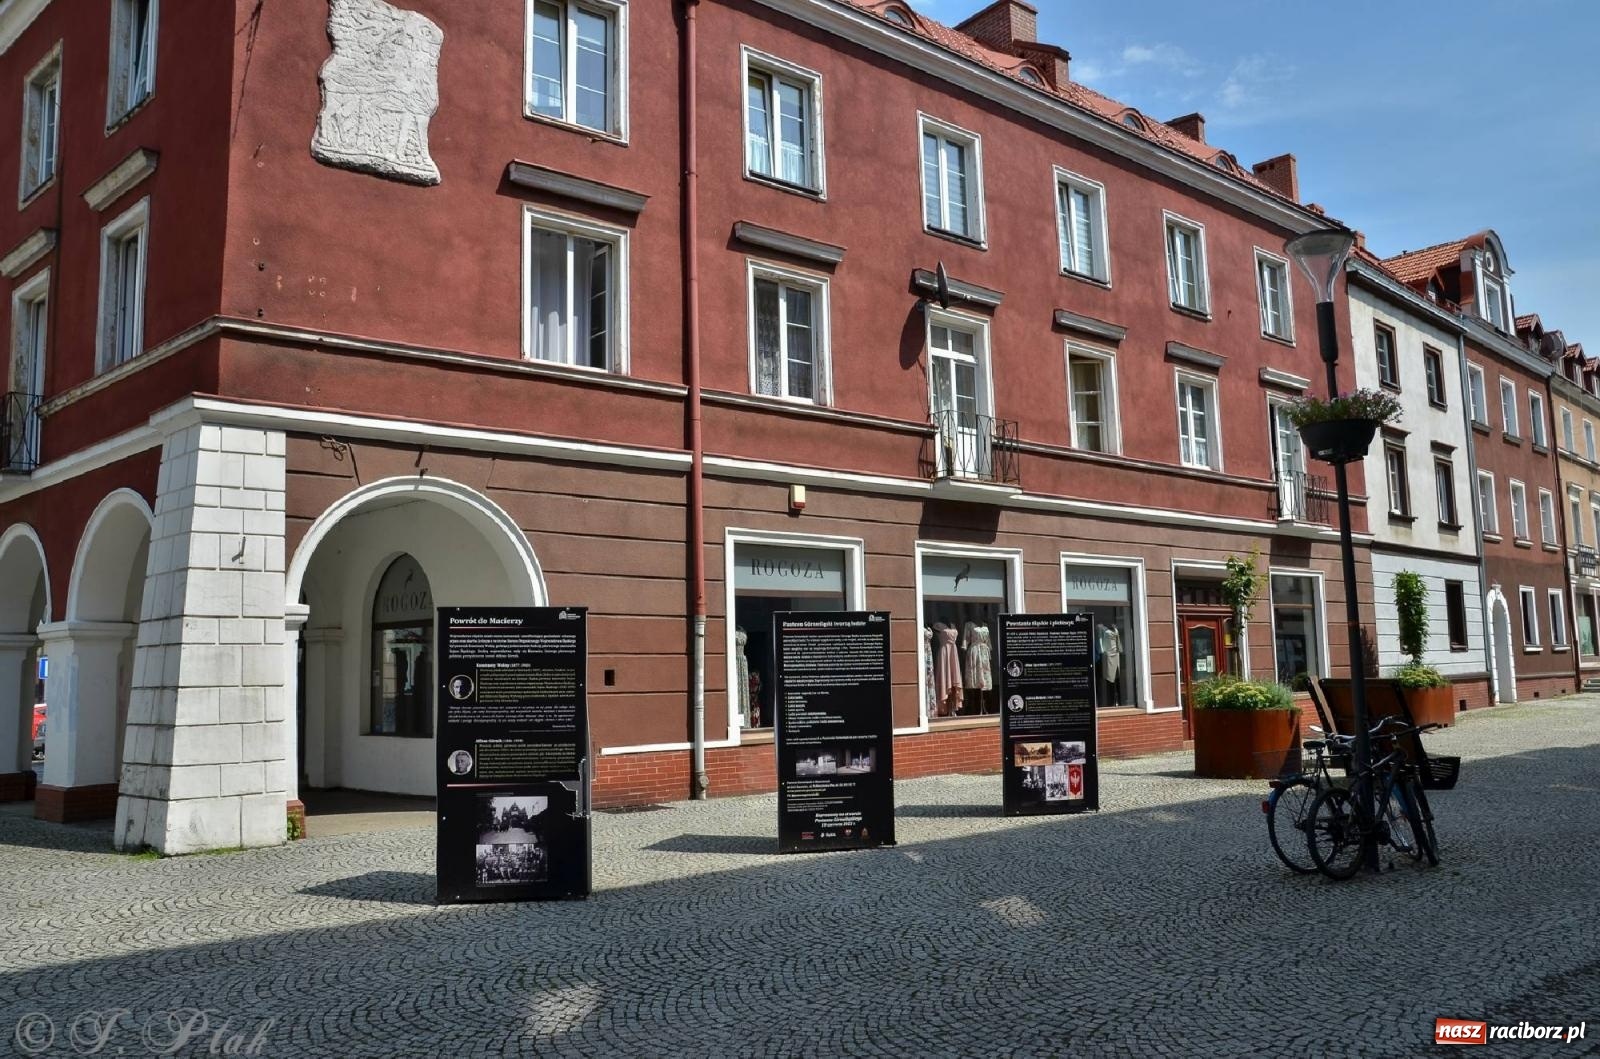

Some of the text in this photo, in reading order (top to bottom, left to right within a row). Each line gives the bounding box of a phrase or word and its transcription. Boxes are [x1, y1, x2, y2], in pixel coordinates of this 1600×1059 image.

[751, 558, 824, 579] ROGOZA
[1071, 575, 1118, 592] ROGOZA
[384, 591, 433, 613] ROGOZ
[489, 617, 524, 626] Macierzy
